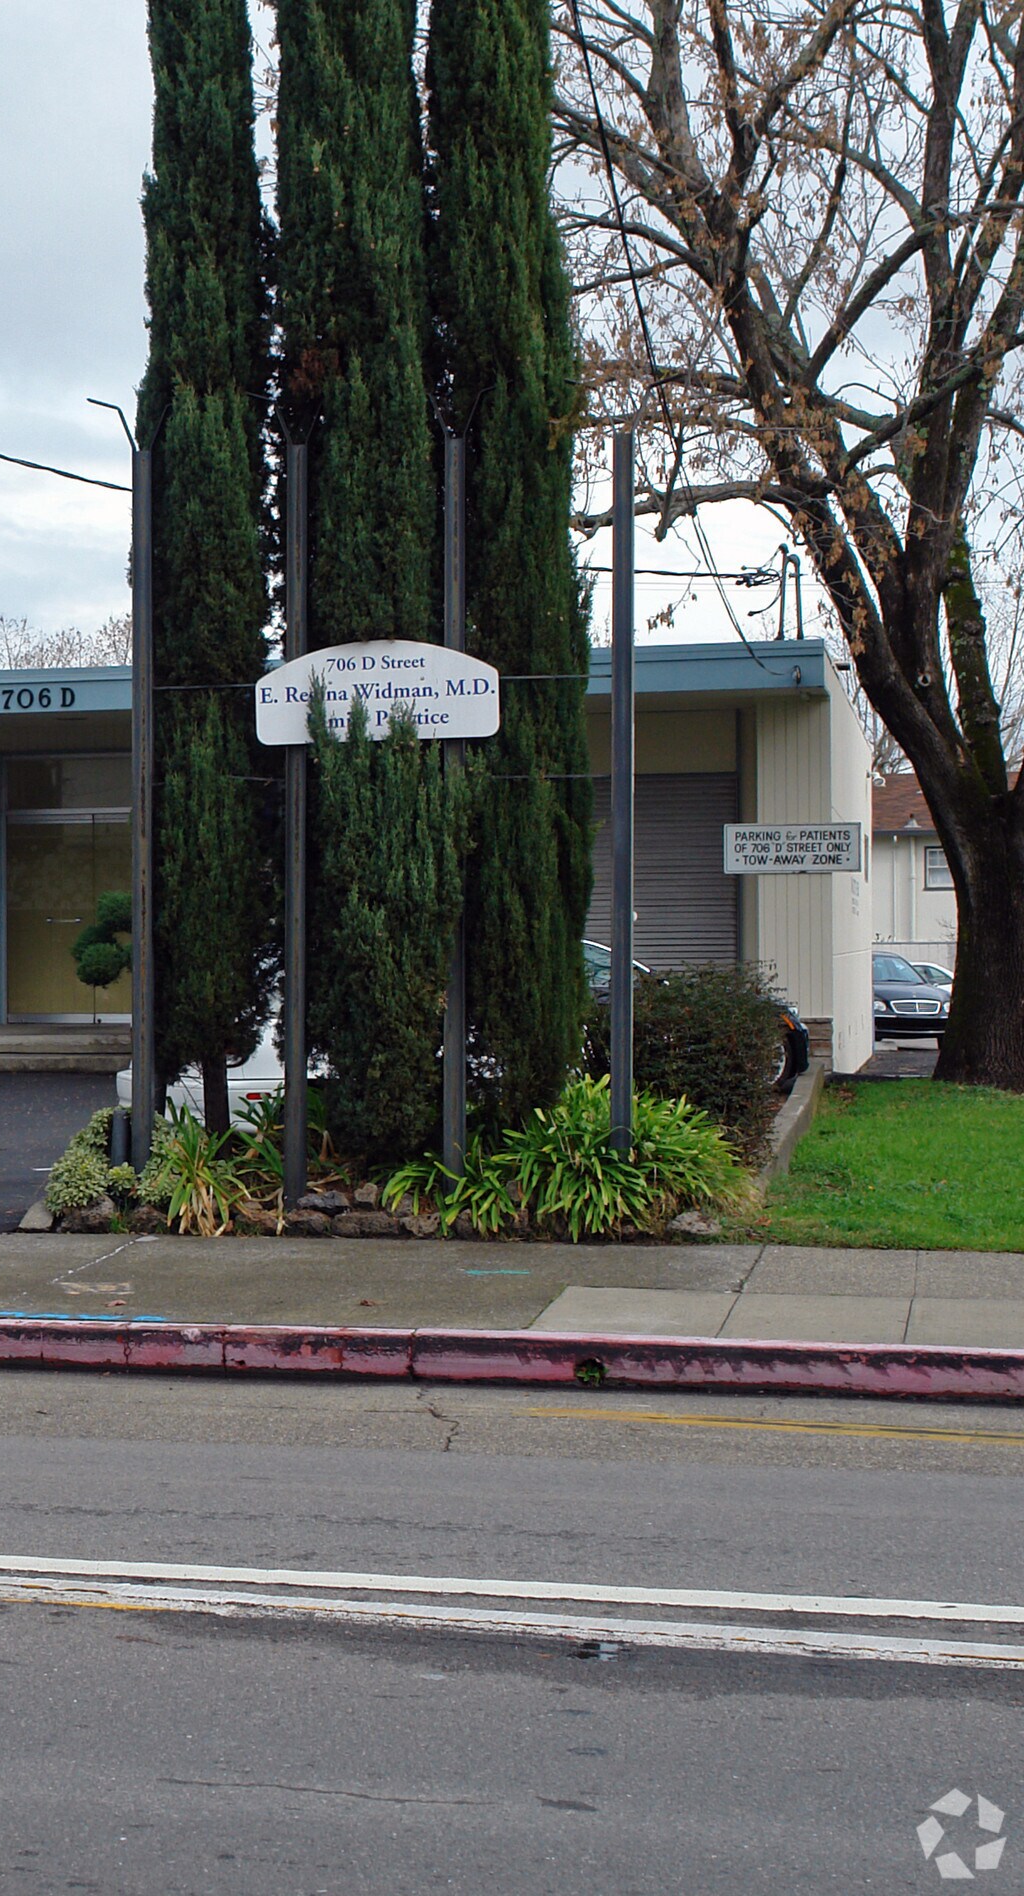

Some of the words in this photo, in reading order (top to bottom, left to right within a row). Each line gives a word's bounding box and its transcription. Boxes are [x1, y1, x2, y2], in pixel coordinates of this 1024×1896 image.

[326, 656, 356, 673] 706
[361, 656, 376, 671] D
[380, 655, 426, 670] Street
[1, 688, 52, 710] 706
[60, 687, 76, 708] D
[260, 687, 279, 704] E.
[285, 686, 349, 705] Rena
[352, 682, 440, 701] Widman,
[445, 678, 496, 697] M.D.
[735, 831, 781, 842] PARKING
[785, 830, 798, 841] for
[799, 830, 851, 841] PATIENTS
[734, 843, 747, 853] OF
[751, 843, 771, 853] 706
[786, 842, 823, 853] STREET
[826, 842, 851, 852] ONLY
[742, 854, 807, 865] TOW-AWAY
[812, 854, 843, 865] ZONE
